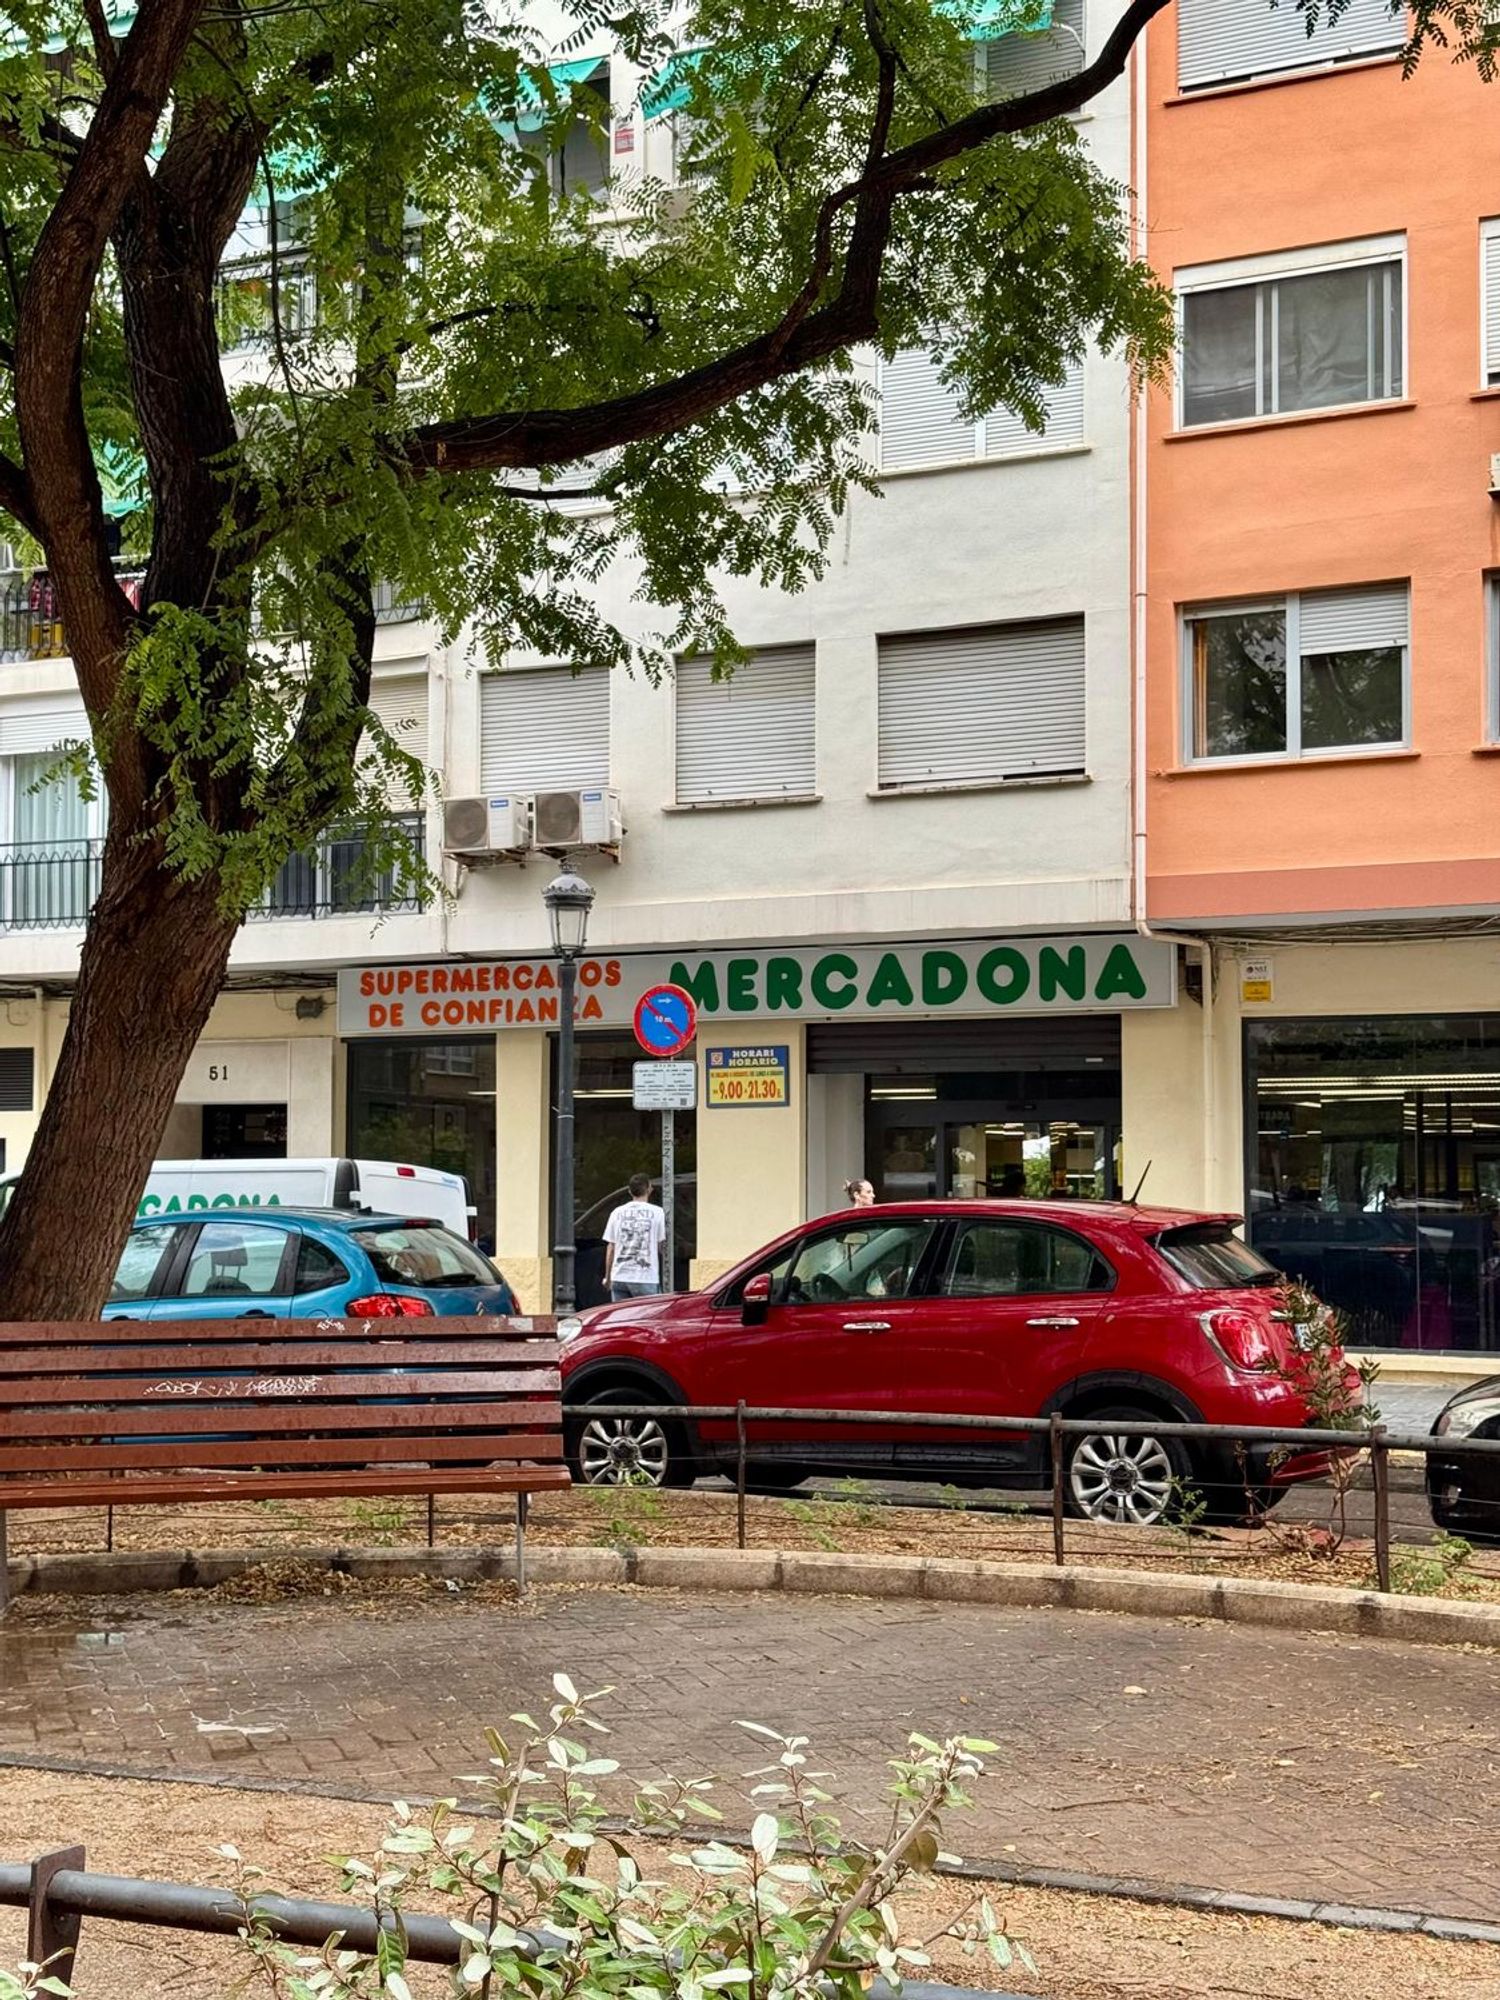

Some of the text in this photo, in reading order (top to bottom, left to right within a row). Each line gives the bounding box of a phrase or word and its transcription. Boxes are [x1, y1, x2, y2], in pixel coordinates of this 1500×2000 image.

[360, 960, 622, 996] SUPERMERCAOS
[668, 943, 1148, 1013] MERCADONA
[368, 993, 603, 1028] DE CONFIANA
